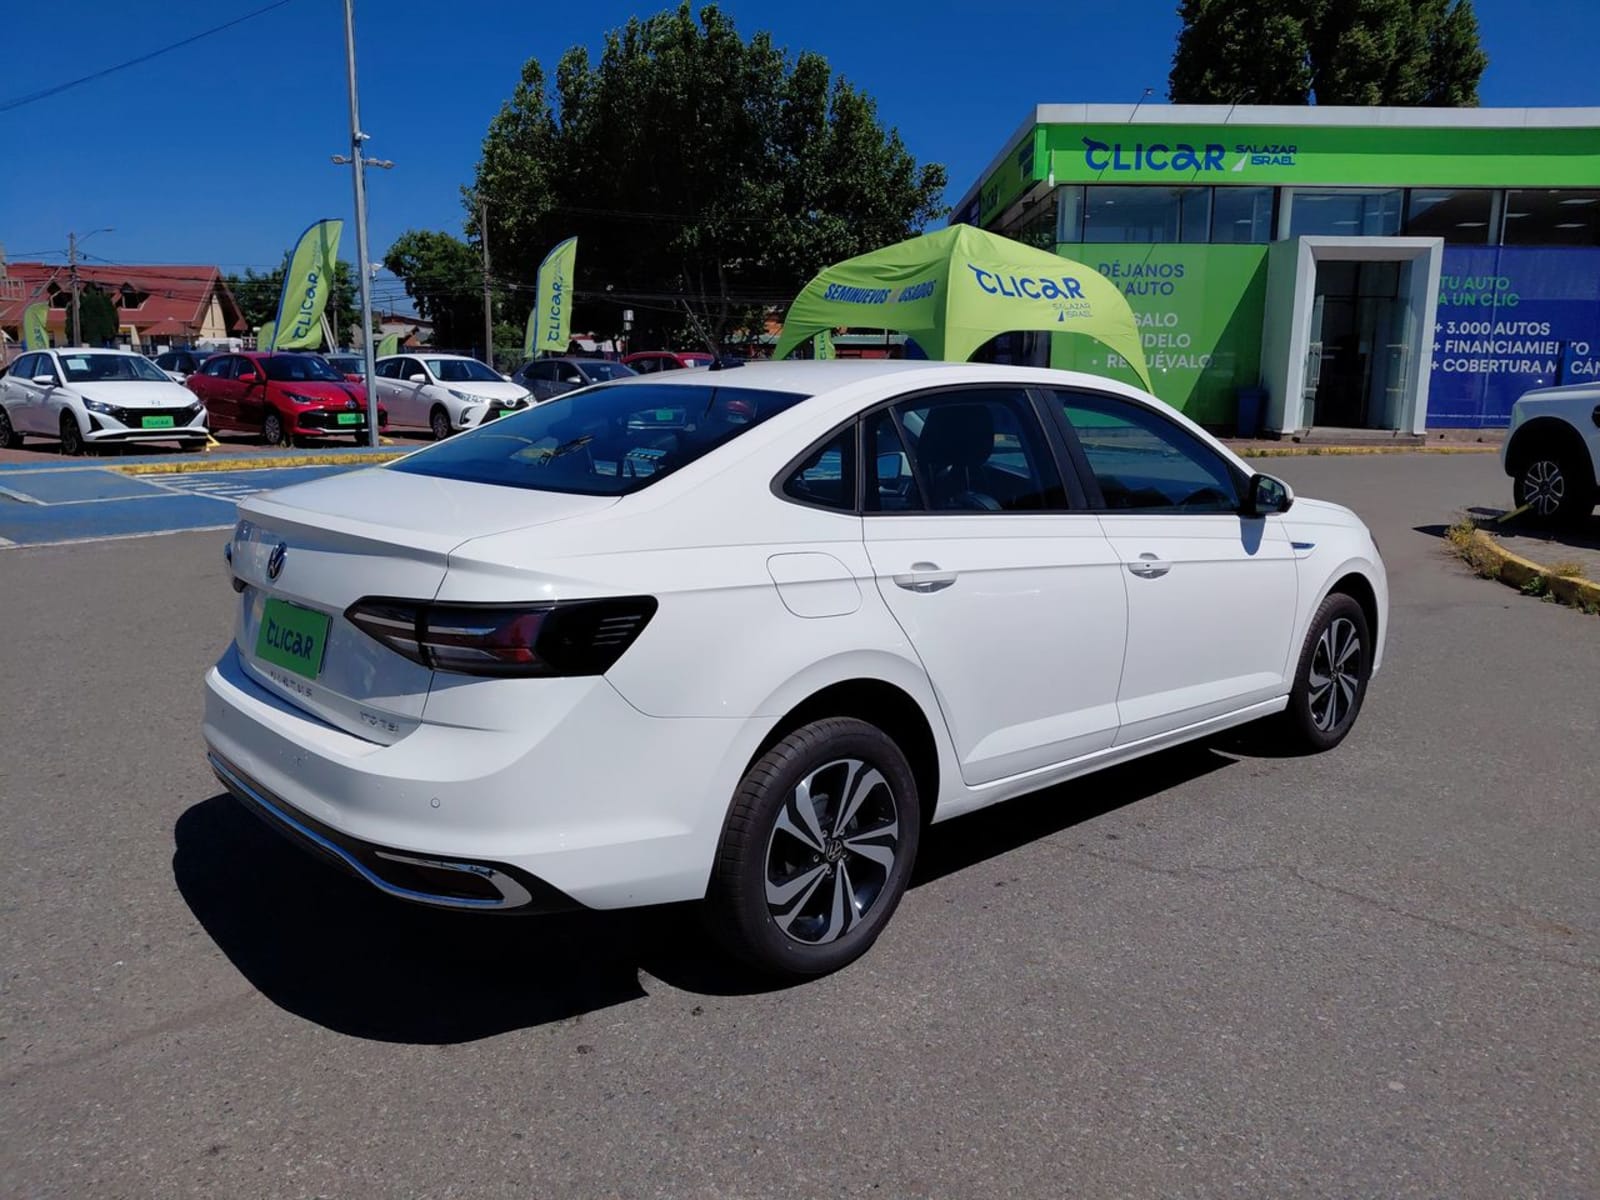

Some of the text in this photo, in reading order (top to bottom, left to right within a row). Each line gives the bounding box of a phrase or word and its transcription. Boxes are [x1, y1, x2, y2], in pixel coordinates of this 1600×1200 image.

[1235, 144, 1297, 154] SALAZAR
[1251, 155, 1296, 166] ISRAEL
[1098, 259, 1185, 278] DÉJANOS
[1125, 281, 1174, 296] AUTO
[1440, 276, 1510, 291] TU AUTO
[824, 283, 892, 304] SEMINUEVOS
[1438, 293, 1520, 307] A UN CLIC
[1446, 321, 1491, 335] 3.000
[1493, 321, 1551, 336] AUTOS
[1442, 359, 1542, 374] COBERTURA
